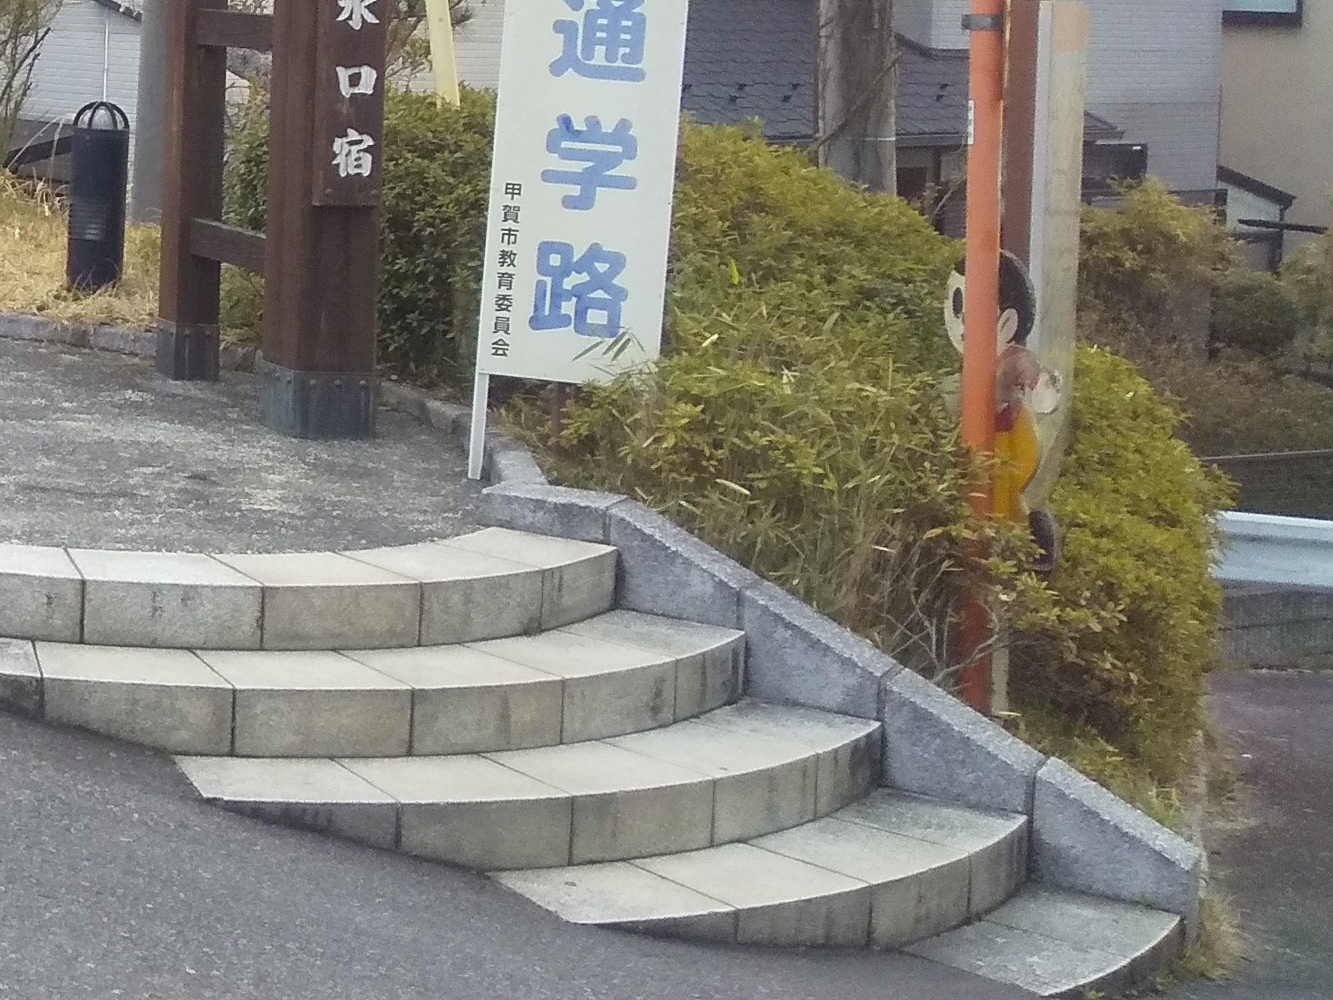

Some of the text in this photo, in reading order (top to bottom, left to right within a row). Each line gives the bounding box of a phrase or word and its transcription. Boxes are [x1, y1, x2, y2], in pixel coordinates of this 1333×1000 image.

[491, 181, 522, 358] 甲賀市教育委員会
